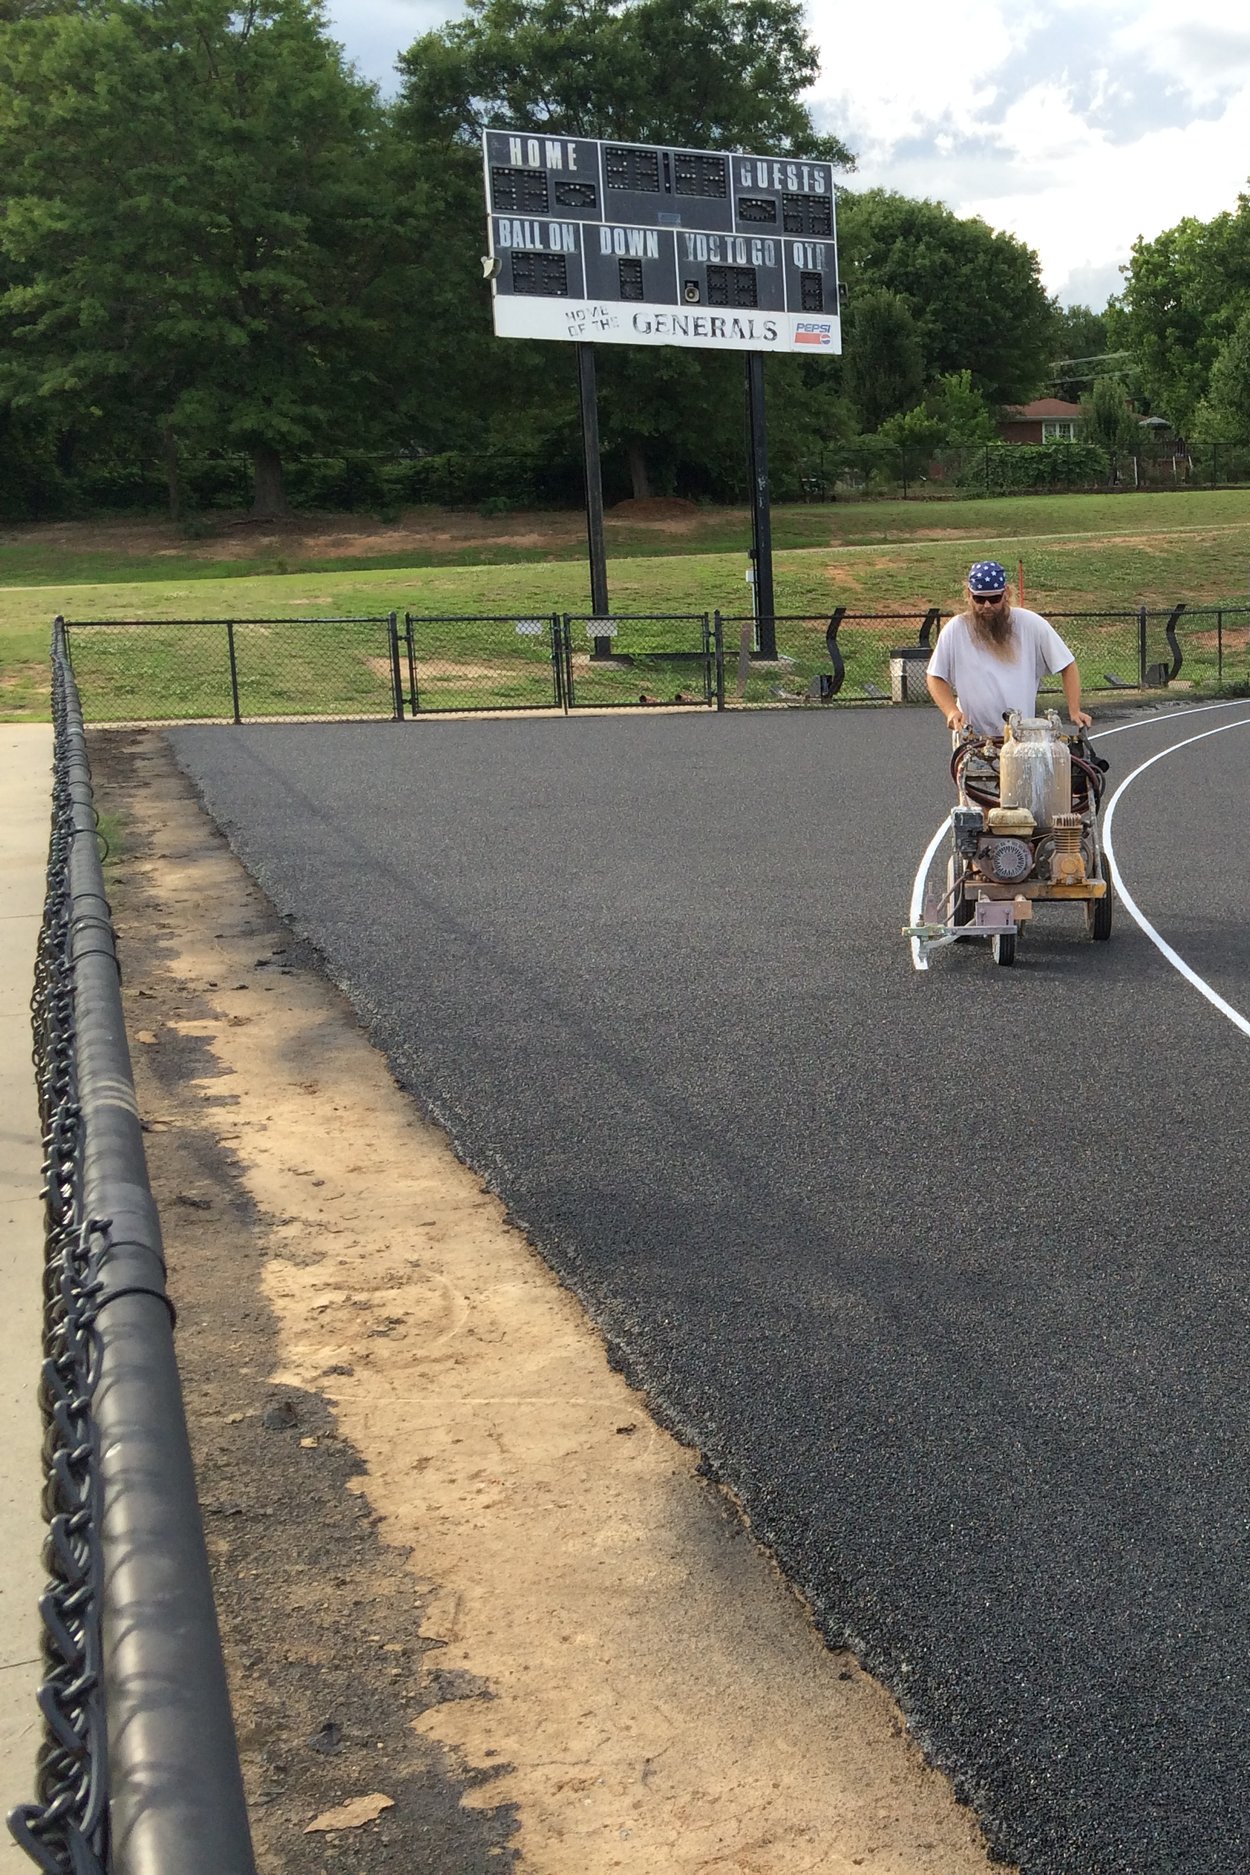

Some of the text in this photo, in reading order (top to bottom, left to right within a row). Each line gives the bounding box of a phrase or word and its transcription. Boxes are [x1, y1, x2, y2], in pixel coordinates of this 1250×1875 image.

[509, 137, 578, 171] HOME
[741, 161, 825, 194] GUESTS
[499, 219, 575, 252] BALL ON
[600, 227, 659, 259] DOWN
[685, 233, 775, 266] YDS TO GO
[793, 242, 825, 270] QTR
[632, 312, 778, 342] GENERALS
[796, 322, 831, 334] PEPSI
